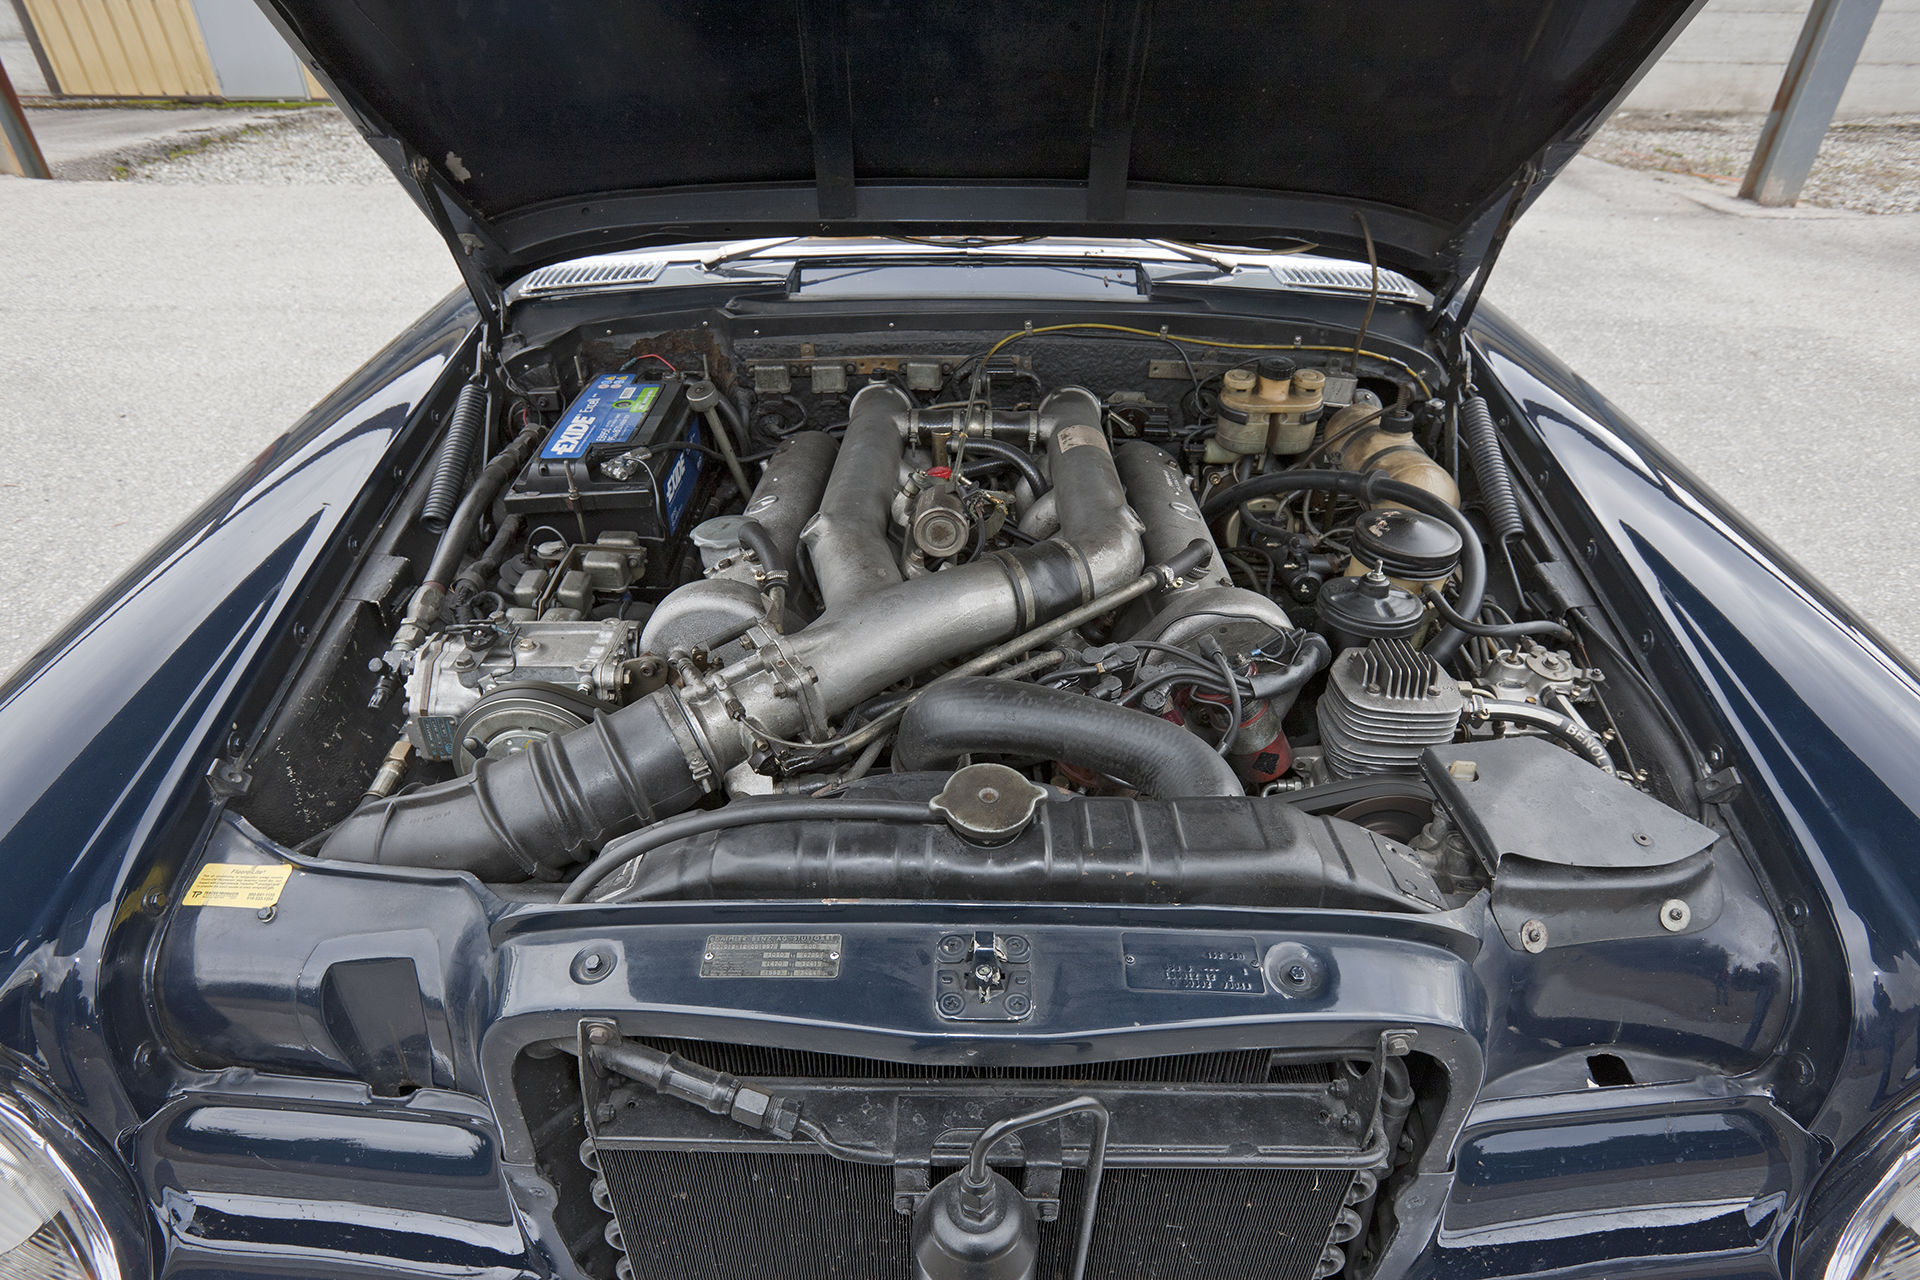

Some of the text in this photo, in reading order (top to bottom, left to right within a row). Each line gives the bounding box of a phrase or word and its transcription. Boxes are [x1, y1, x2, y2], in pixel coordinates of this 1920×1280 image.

[551, 415, 596, 455] EXIDE
[666, 452, 686, 503] EXIDE
[1565, 723, 1606, 765] BENOL
